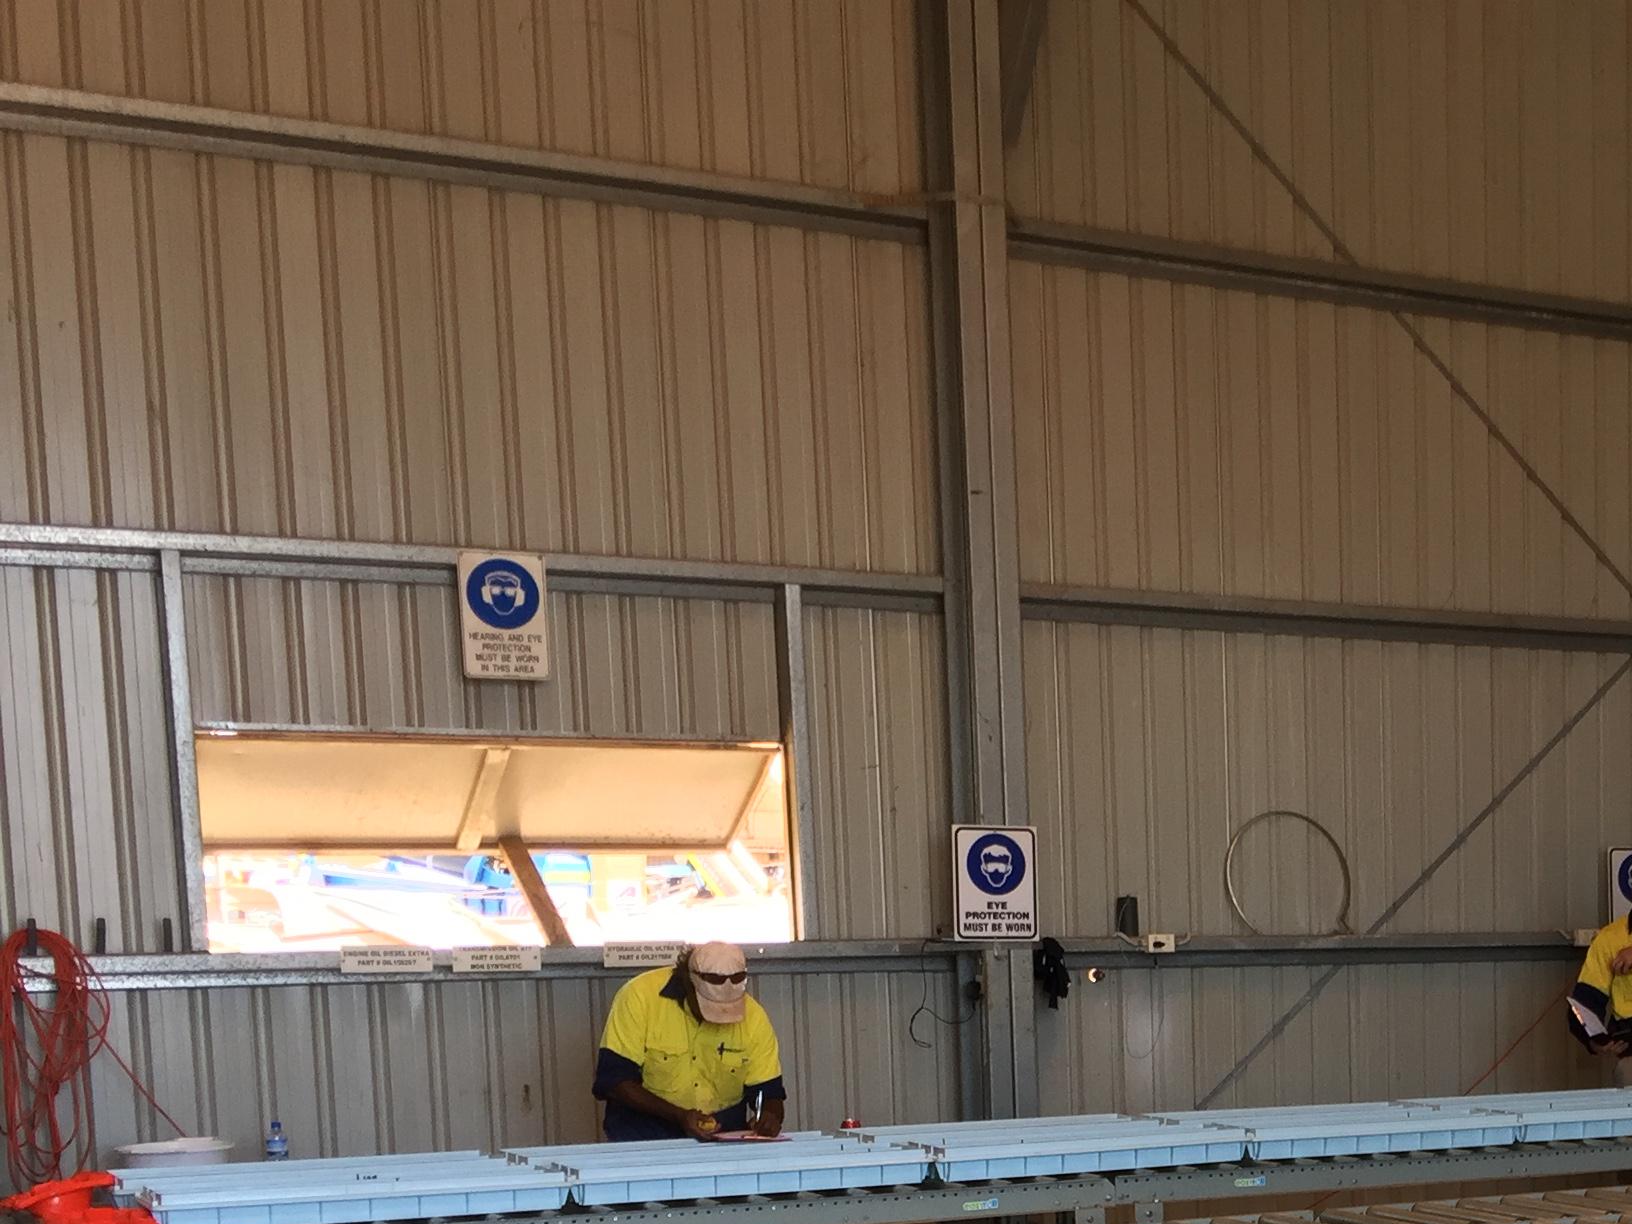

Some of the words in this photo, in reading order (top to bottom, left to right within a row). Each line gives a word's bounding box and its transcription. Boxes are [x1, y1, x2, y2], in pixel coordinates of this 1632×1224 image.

[468, 632, 504, 641] HEARING
[508, 633, 524, 641] AND
[527, 634, 543, 643] EYE
[482, 643, 532, 652] PROTECTION
[475, 653, 497, 661] MUST
[501, 654, 511, 662] BE
[515, 654, 540, 663] WORN
[481, 663, 489, 671] IN
[493, 664, 511, 672] THIS
[513, 665, 535, 673] AREA
[987, 901, 1008, 910] EYE
[965, 911, 1030, 920] PROTECTION
[963, 923, 989, 932] MUST
[991, 923, 1003, 932] BE
[1005, 923, 1032, 932] WORN
